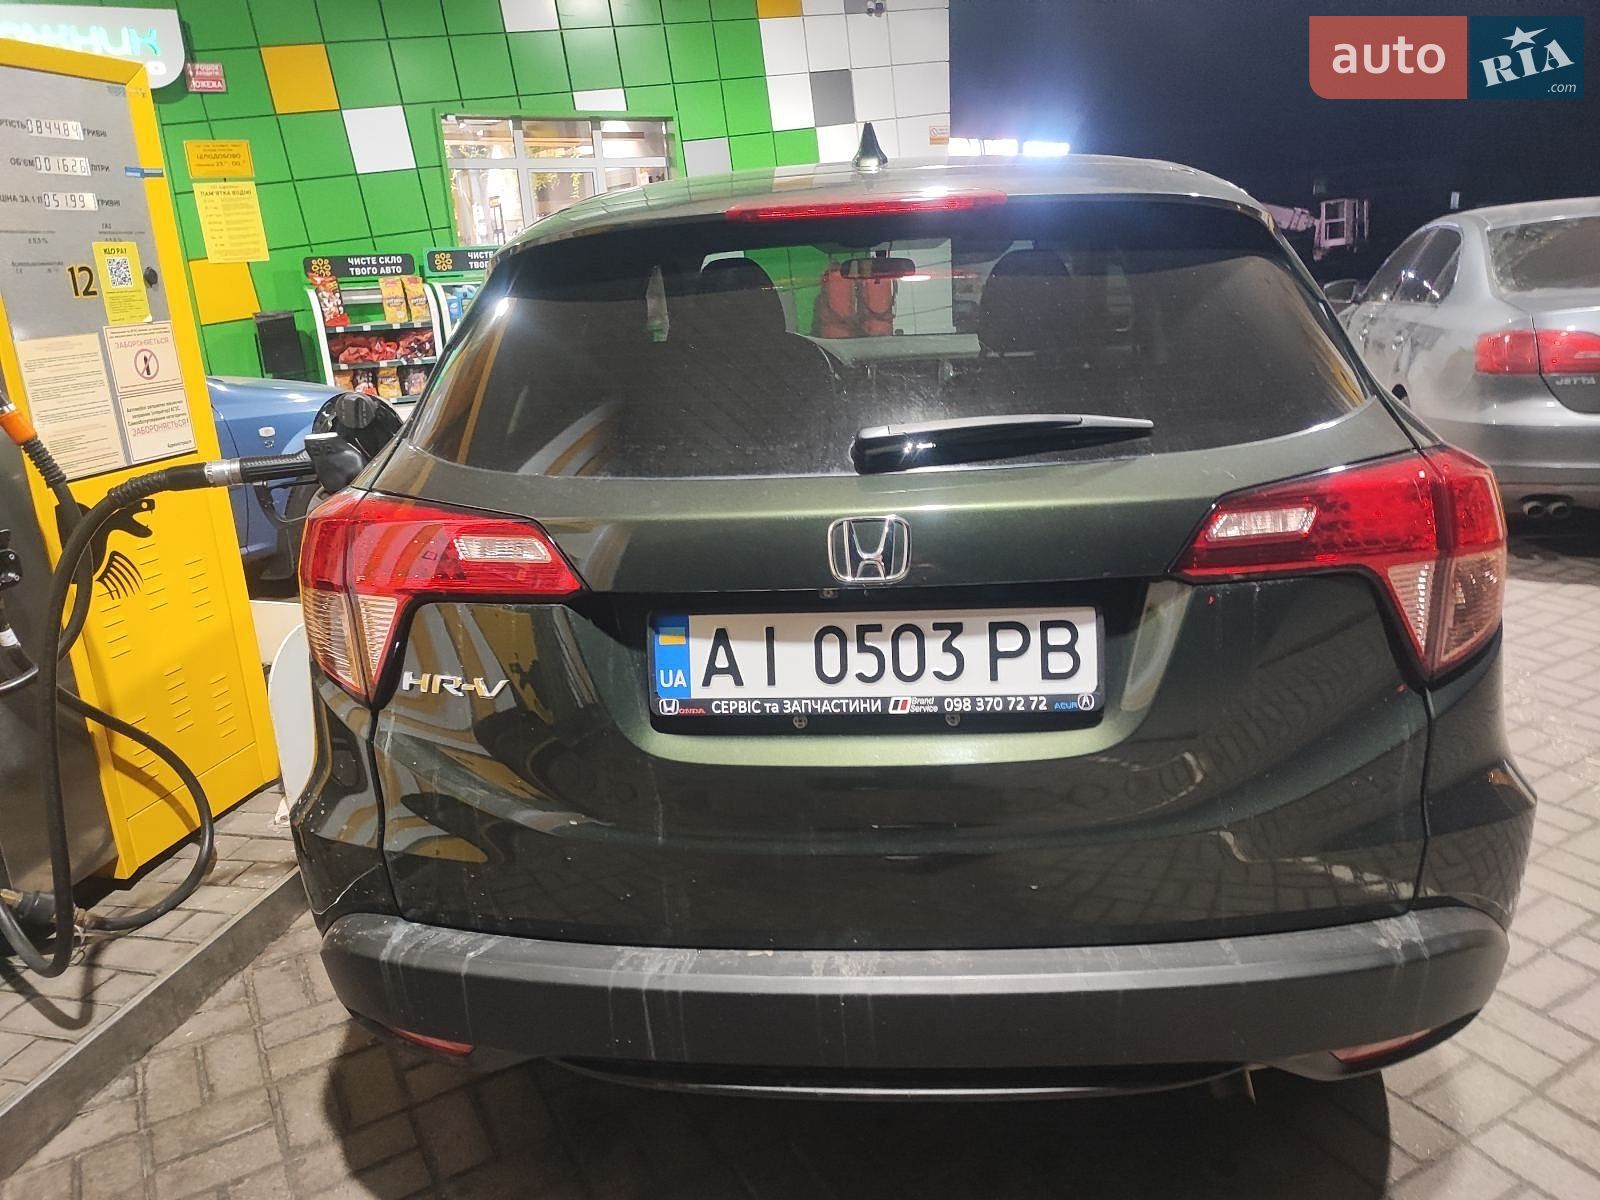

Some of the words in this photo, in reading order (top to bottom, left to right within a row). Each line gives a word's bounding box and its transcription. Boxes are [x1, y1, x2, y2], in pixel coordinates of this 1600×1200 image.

[26, 119, 80, 137] 084484
[35, 156, 86, 173] 001626
[348, 257, 377, 265] ЧИСТЕ
[379, 255, 403, 264] СКЛО
[467, 251, 494, 260] ЧИСТЕ
[349, 266, 378, 275] ТВОГО
[379, 265, 403, 274] АВТО
[468, 260, 489, 269] ТВОГ
[68, 266, 98, 297] 12
[1555, 375, 1597, 386] JETTA
[701, 626, 776, 687] AI
[813, 622, 965, 685] 0503
[987, 619, 1081, 682] PB
[402, 672, 510, 699] HR-V
[660, 669, 688, 688] UA
[711, 700, 762, 714] СЕРВІС
[765, 703, 779, 714] та
[783, 699, 882, 714] ЗАПЧАСТИНИ
[911, 696, 936, 705] Brand
[944, 697, 972, 712] 098
[975, 697, 1003, 711] 370
[1007, 696, 1025, 711] 72
[1029, 696, 1048, 711] 72
[910, 704, 939, 713] Service
